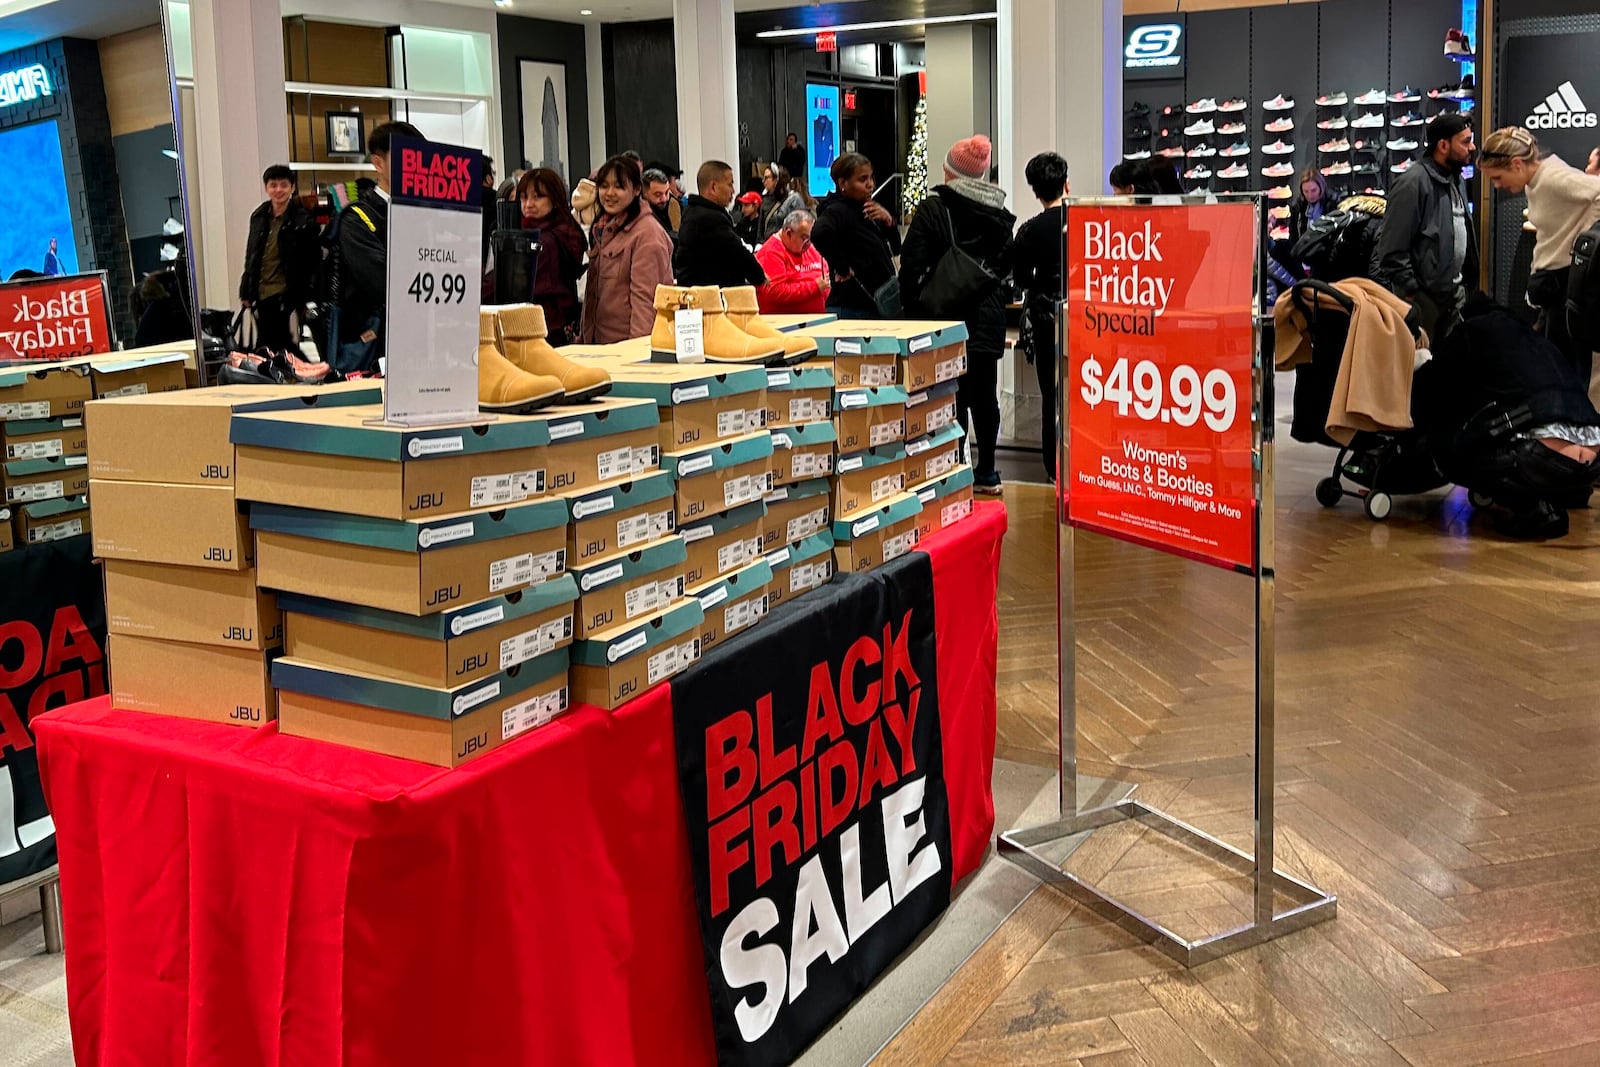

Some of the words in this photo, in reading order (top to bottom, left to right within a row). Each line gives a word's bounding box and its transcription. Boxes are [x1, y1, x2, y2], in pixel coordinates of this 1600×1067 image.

[1525, 110, 1598, 130] adidas
[402, 148, 471, 181] BLACK
[402, 172, 471, 202] FRIDAY
[1084, 219, 1163, 262] Black
[418, 247, 457, 263] SPECIAL
[408, 271, 466, 305] 49.99
[1084, 263, 1175, 317] Friday
[1085, 304, 1155, 337] Special
[1080, 353, 1237, 433] $49.99
[678, 429, 700, 445] JBU
[1122, 439, 1188, 471] Women's
[201, 465, 230, 479] JBU
[548, 472, 575, 489] JBU
[1101, 455, 1140, 481] Boots
[1143, 465, 1154, 484] &
[1157, 468, 1213, 497] Booties
[409, 492, 443, 511] JBU
[1079, 471, 1096, 485] from
[1147, 487, 1181, 506] Tommy
[1177, 494, 1207, 513] Hilfiger
[1209, 501, 1217, 514] &
[1218, 504, 1242, 520] More
[683, 500, 705, 517] JBU
[204, 547, 232, 562] JBU
[581, 538, 606, 558] JBU
[426, 584, 461, 606] JBU
[587, 608, 613, 631] JBU
[222, 626, 252, 641] JBU
[455, 652, 488, 676] JBU
[614, 676, 637, 701] JBU
[230, 705, 260, 721] JBU
[705, 607, 922, 823] BLACK
[458, 731, 487, 758] JBU
[707, 687, 922, 919] FRIDAY
[719, 775, 942, 1043] SALE
